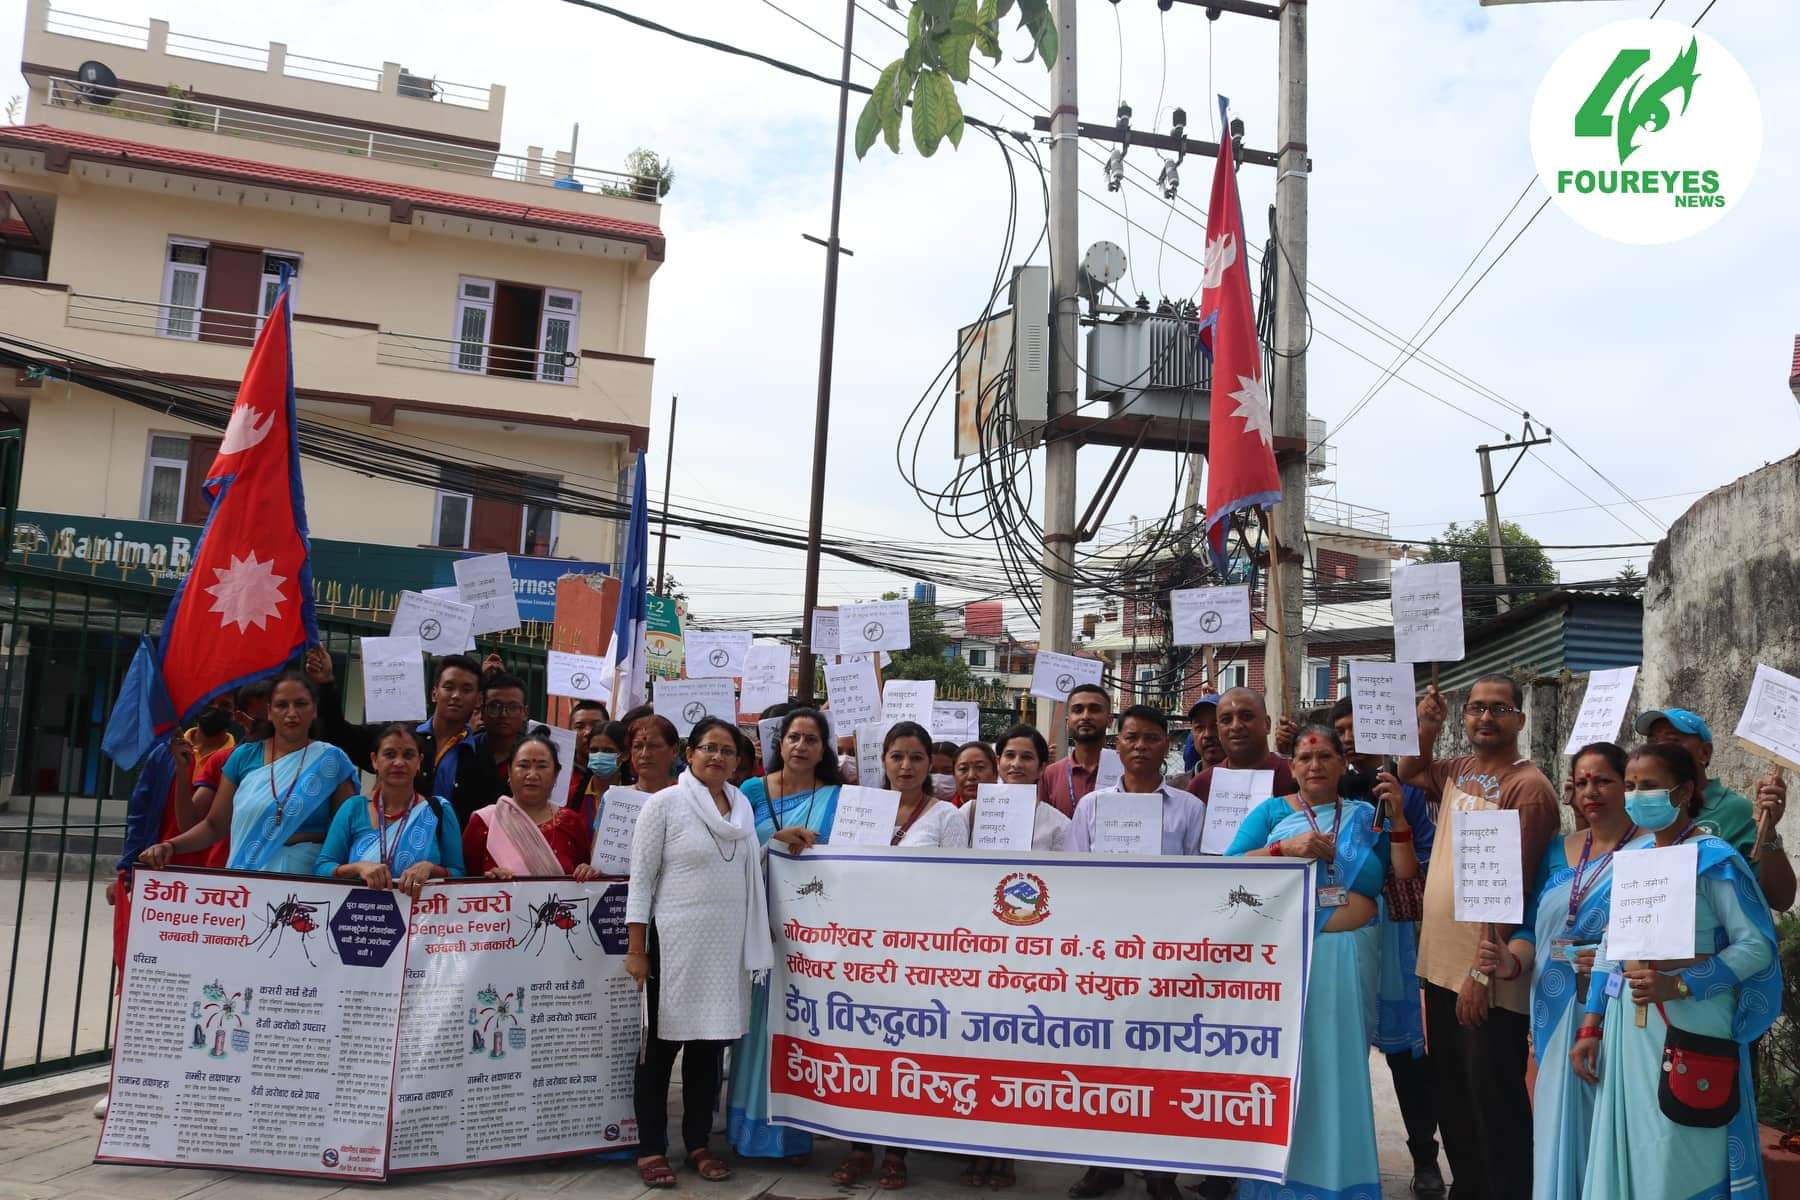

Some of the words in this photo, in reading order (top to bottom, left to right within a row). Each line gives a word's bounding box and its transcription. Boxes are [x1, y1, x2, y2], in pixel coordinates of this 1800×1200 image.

[511, 577, 557, 596] arnes
[195, 885, 252, 908] ज्वरो
[457, 890, 513, 913] ज्वरो
[142, 907, 199, 926] (Dengue
[202, 912, 246, 930] Fever)
[409, 922, 464, 937] Dengue
[468, 918, 511, 934] Fever)
[202, 934, 250, 948] जानकारी
[882, 928, 1010, 954] नगरपालिका
[1015, 936, 1054, 956] वडा
[1115, 935, 1146, 960] को
[1152, 938, 1254, 963] कार्यालय
[1261, 944, 1279, 965] र
[843, 959, 899, 983] शहरी
[904, 966, 981, 989] स्वास्थ्य
[987, 965, 1068, 993] केन्द्रको
[1076, 971, 1141, 1000] संयुक्त
[1148, 973, 1282, 1002] आयोजनामा
[960, 1004, 1115, 1050] जनचेतना
[1125, 1014, 1283, 1058] कार्यक्रम
[991, 1070, 1154, 1118] जनचेतना
